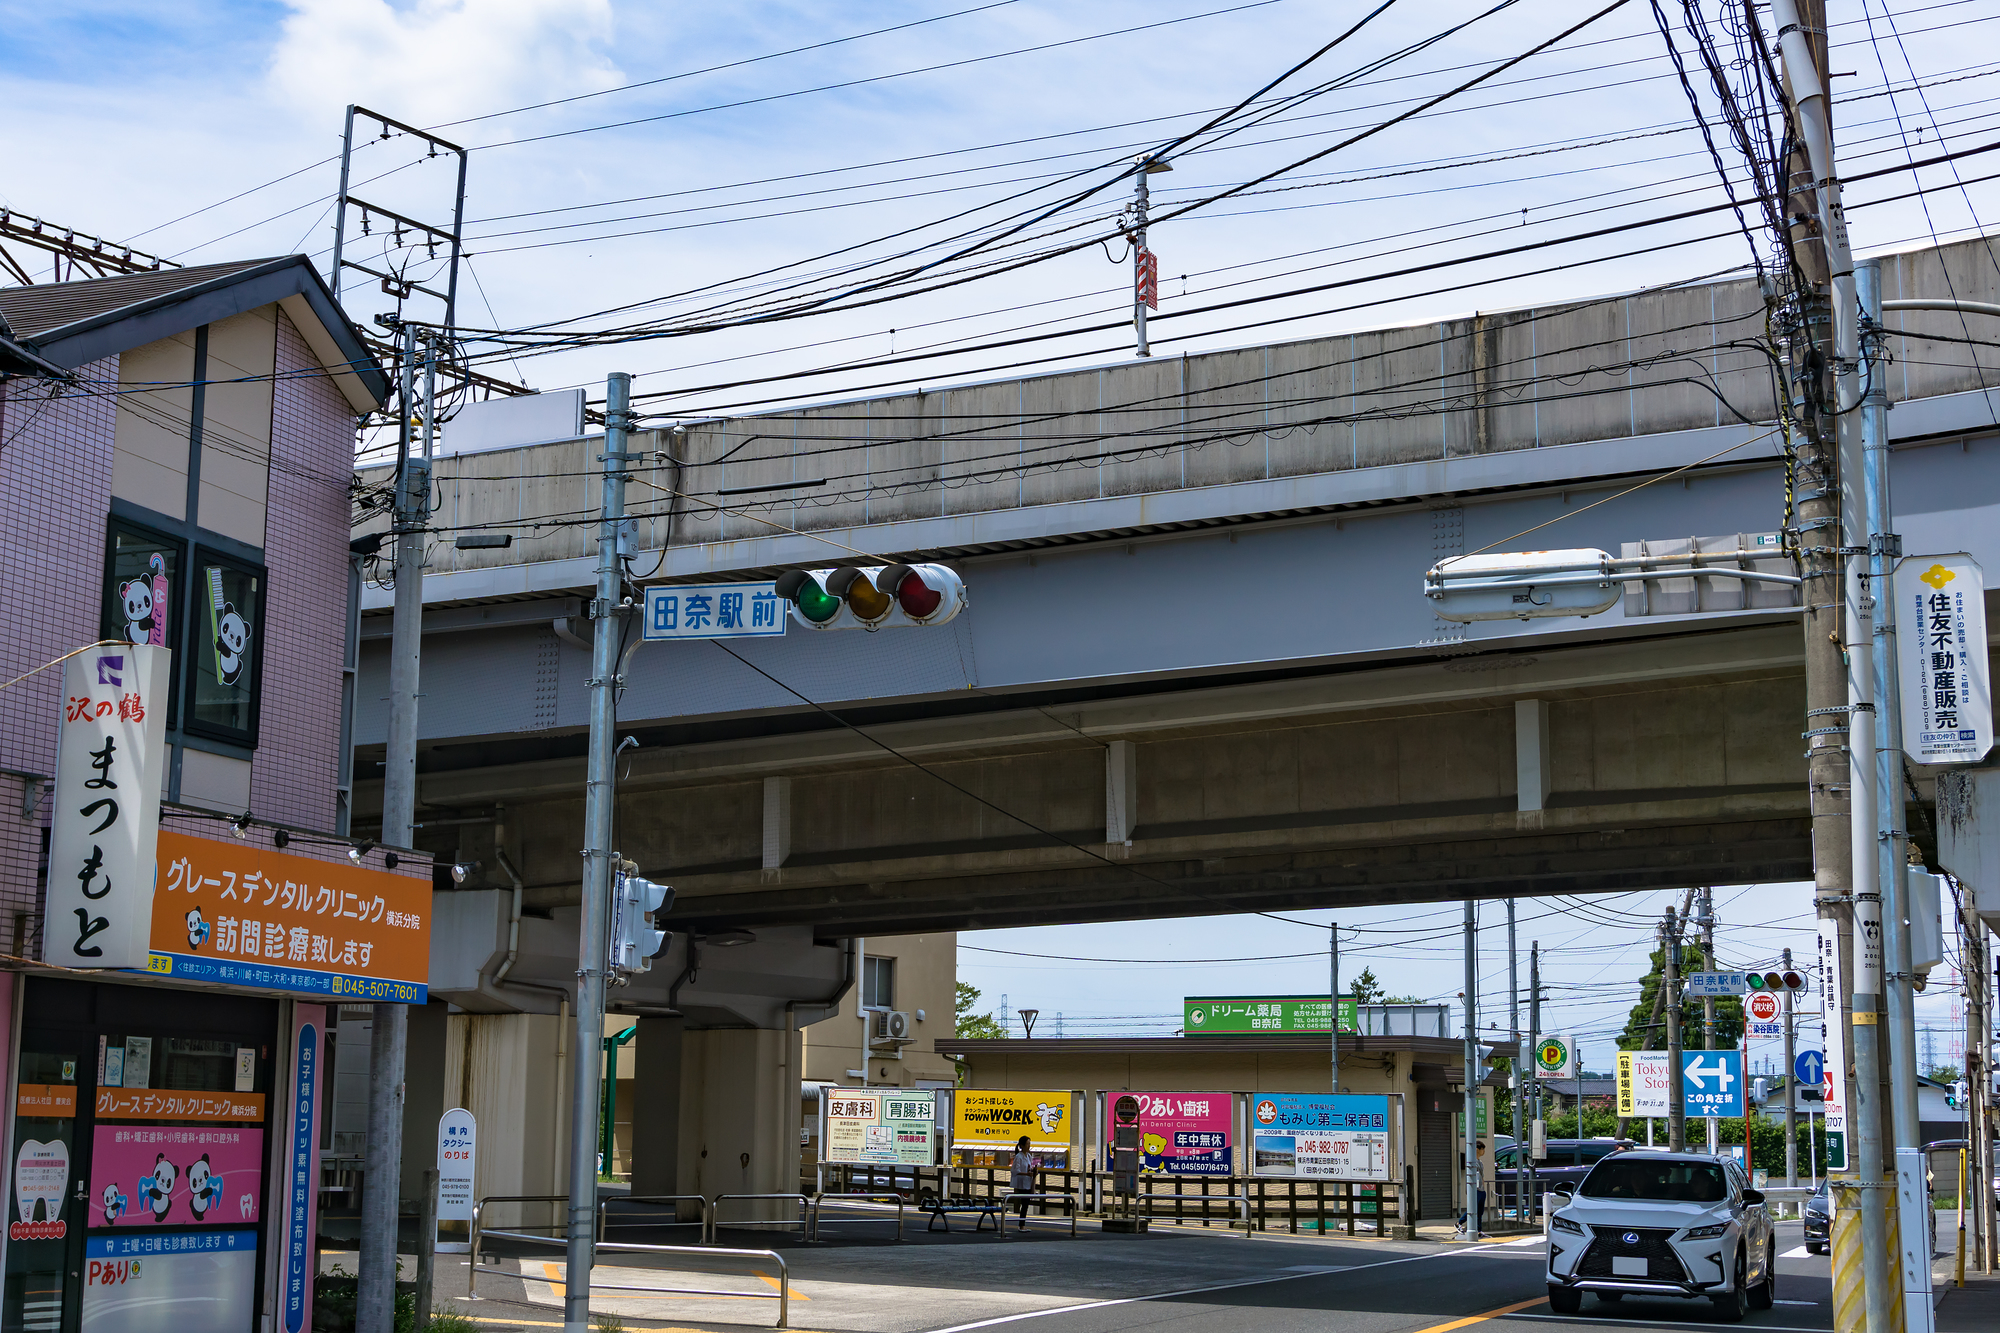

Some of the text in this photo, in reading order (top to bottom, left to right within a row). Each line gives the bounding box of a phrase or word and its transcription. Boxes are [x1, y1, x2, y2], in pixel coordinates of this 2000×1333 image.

[653, 591, 777, 629] 田奈駅前
[1915, 594, 1925, 655] 青葉台営業センター
[1955, 592, 1970, 703] お住まいの売却・購入・ご相談は
[1928, 594, 1959, 729] 住友不動産販売
[66, 693, 146, 724] 沢の鶴
[72, 736, 120, 957] まつもと
[386, 910, 421, 930] 横浜分院
[216, 914, 374, 968] 訪問診療致します
[148, 957, 168, 971] ます
[1693, 975, 1742, 986] 田奈駅前
[343, 978, 418, 1001] 045-507-7601
[1211, 1004, 1283, 1018] ドリーム薬局
[1753, 1002, 1774, 1013] 消火栓
[1251, 1018, 1283, 1030] 田奈店
[1753, 1024, 1780, 1035] 染谷医院
[1546, 1048, 1558, 1062] P
[1539, 1060, 1564, 1070] PARKING
[1644, 1076, 1669, 1089] Stor
[965, 1097, 1015, 1106] おシゴト探しなら
[1687, 1093, 1734, 1104] この角左折
[231, 1105, 258, 1117] 横浜分院
[830, 1101, 873, 1117] 皮膚科
[889, 1102, 932, 1119] 胃腸科
[1150, 1097, 1210, 1117] あい歯科
[1701, 1104, 1719, 1115] すぐ
[1279, 1112, 1384, 1128] もみじ第二保育園
[115, 1131, 240, 1144] 歯科・矯正歯科・小児歯科・歯科口腔外科
[448, 1126, 468, 1136] 構内
[442, 1139, 472, 1148] タクシー
[897, 1134, 927, 1143] 内視鏡検査
[1176, 1134, 1222, 1147] 年中無休
[444, 1150, 470, 1160] のりば
[1169, 1162, 1229, 1172] Tel. 045(507)6479
[290, 1047, 312, 1311] お子様のフッ素無料塗布致します
[121, 1234, 222, 1253] 土曜・日曜も診療致します
[88, 1260, 129, 1287] Pあり
